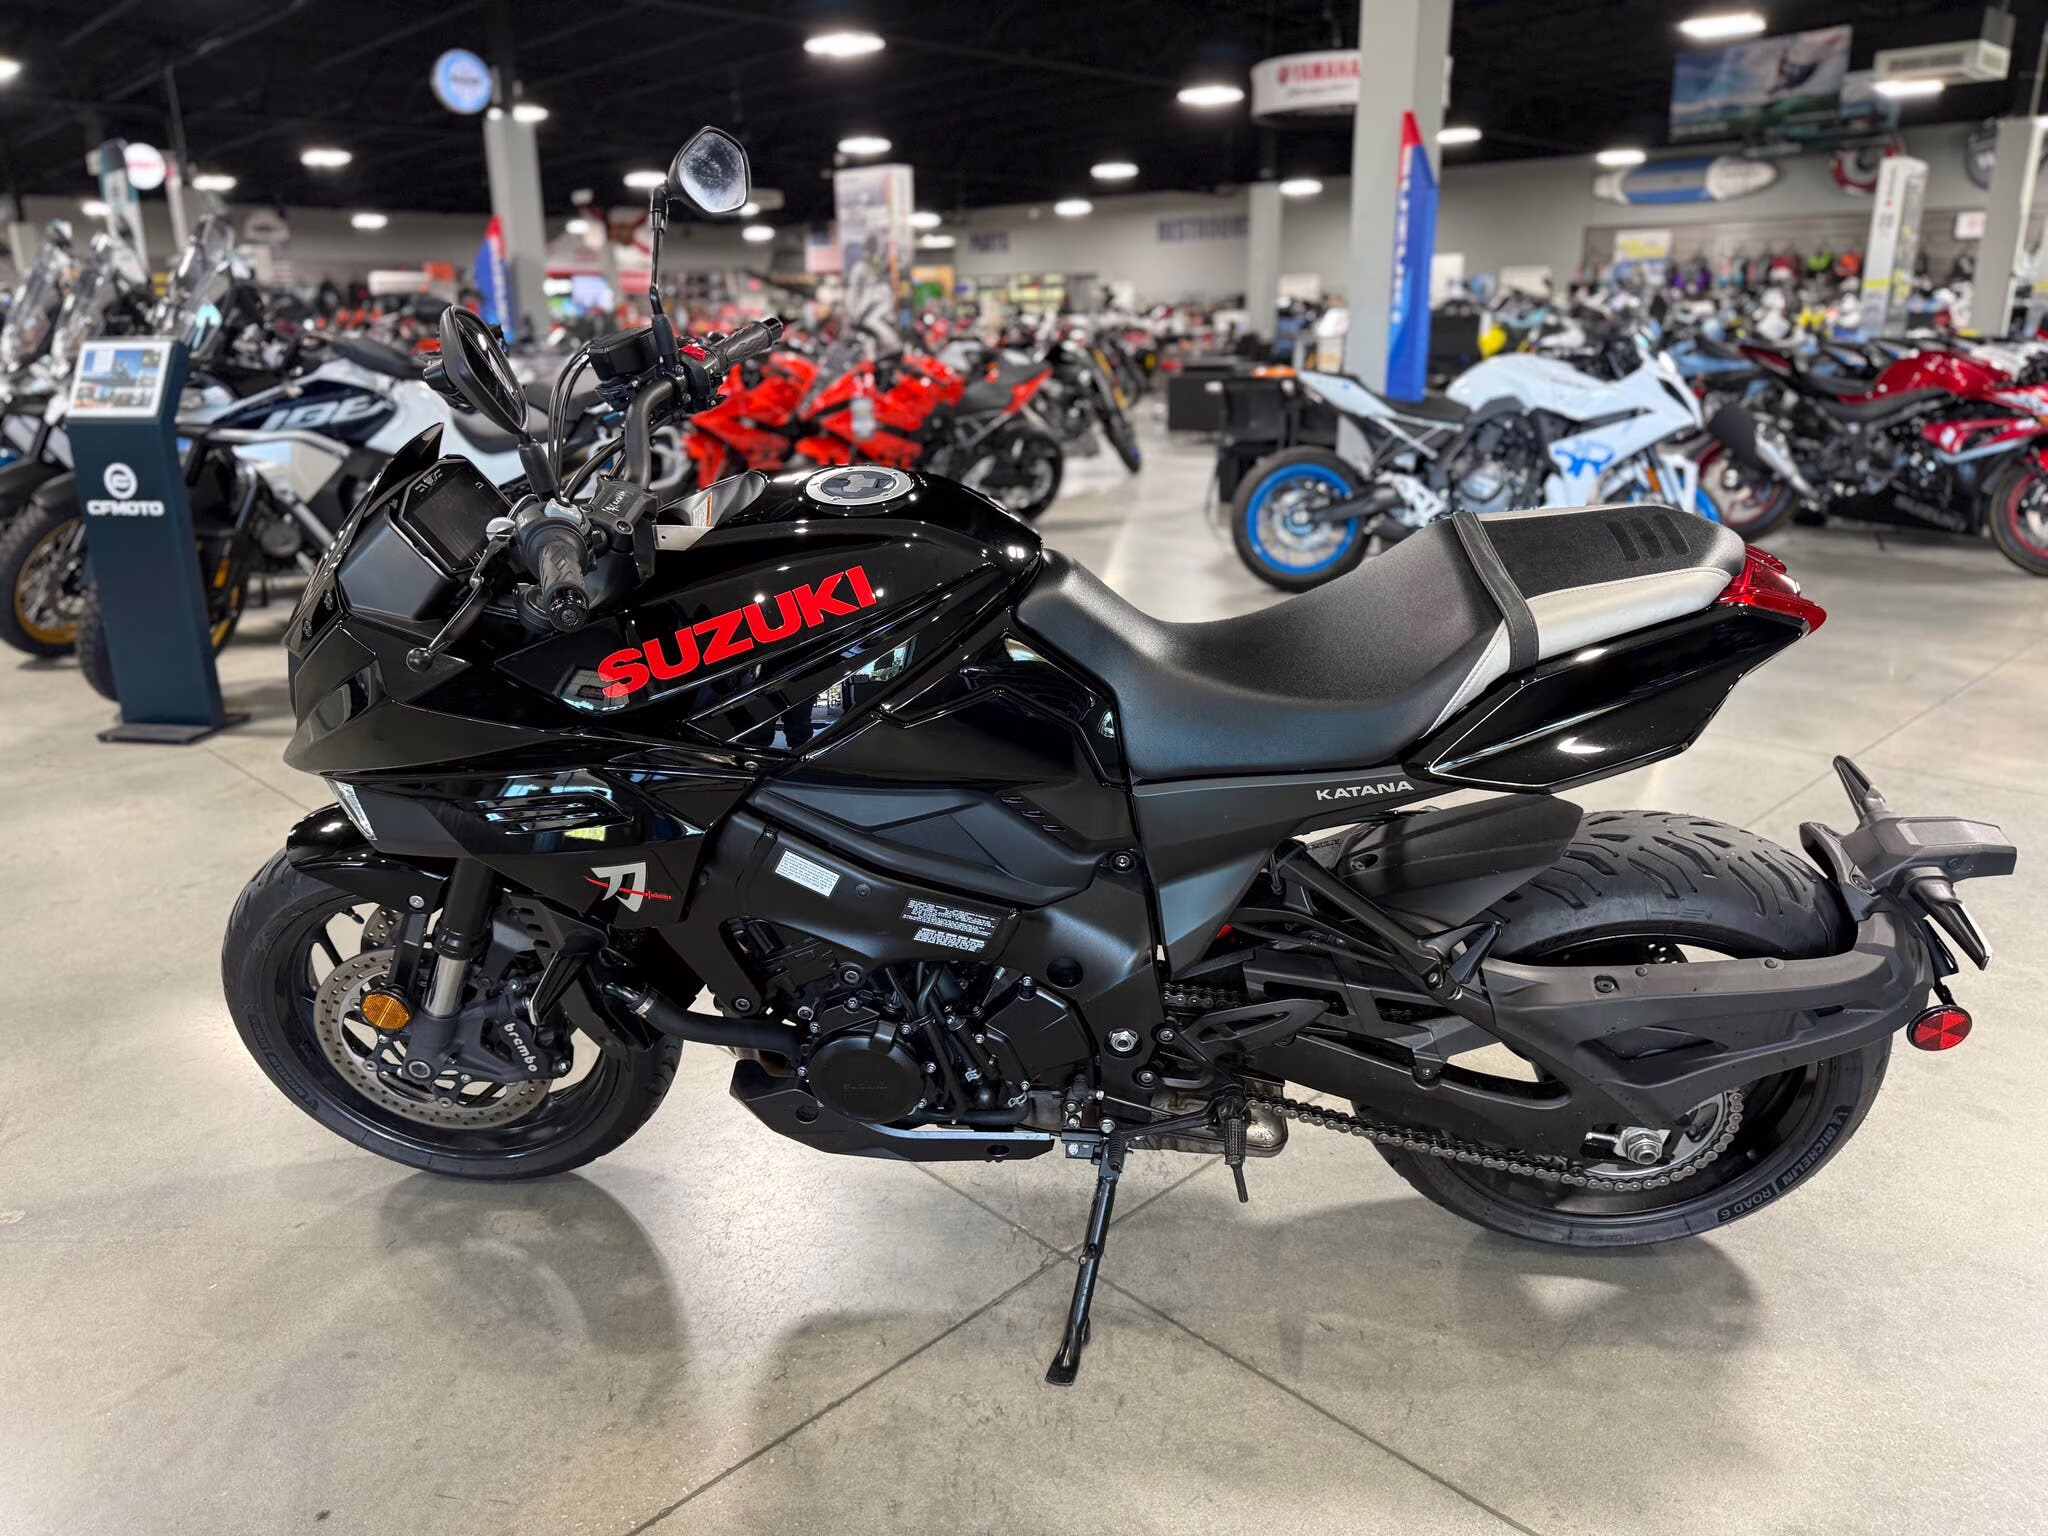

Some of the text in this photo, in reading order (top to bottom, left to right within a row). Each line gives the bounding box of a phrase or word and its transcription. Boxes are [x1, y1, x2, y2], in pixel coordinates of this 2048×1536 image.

[86, 499, 165, 517] CFMOTO
[598, 565, 877, 698] SUZUKI
[1316, 781, 1415, 801] KATANA
[504, 1022, 538, 1072] brembo
[1720, 1126, 1837, 1220] MICHELIN ROAD 6
